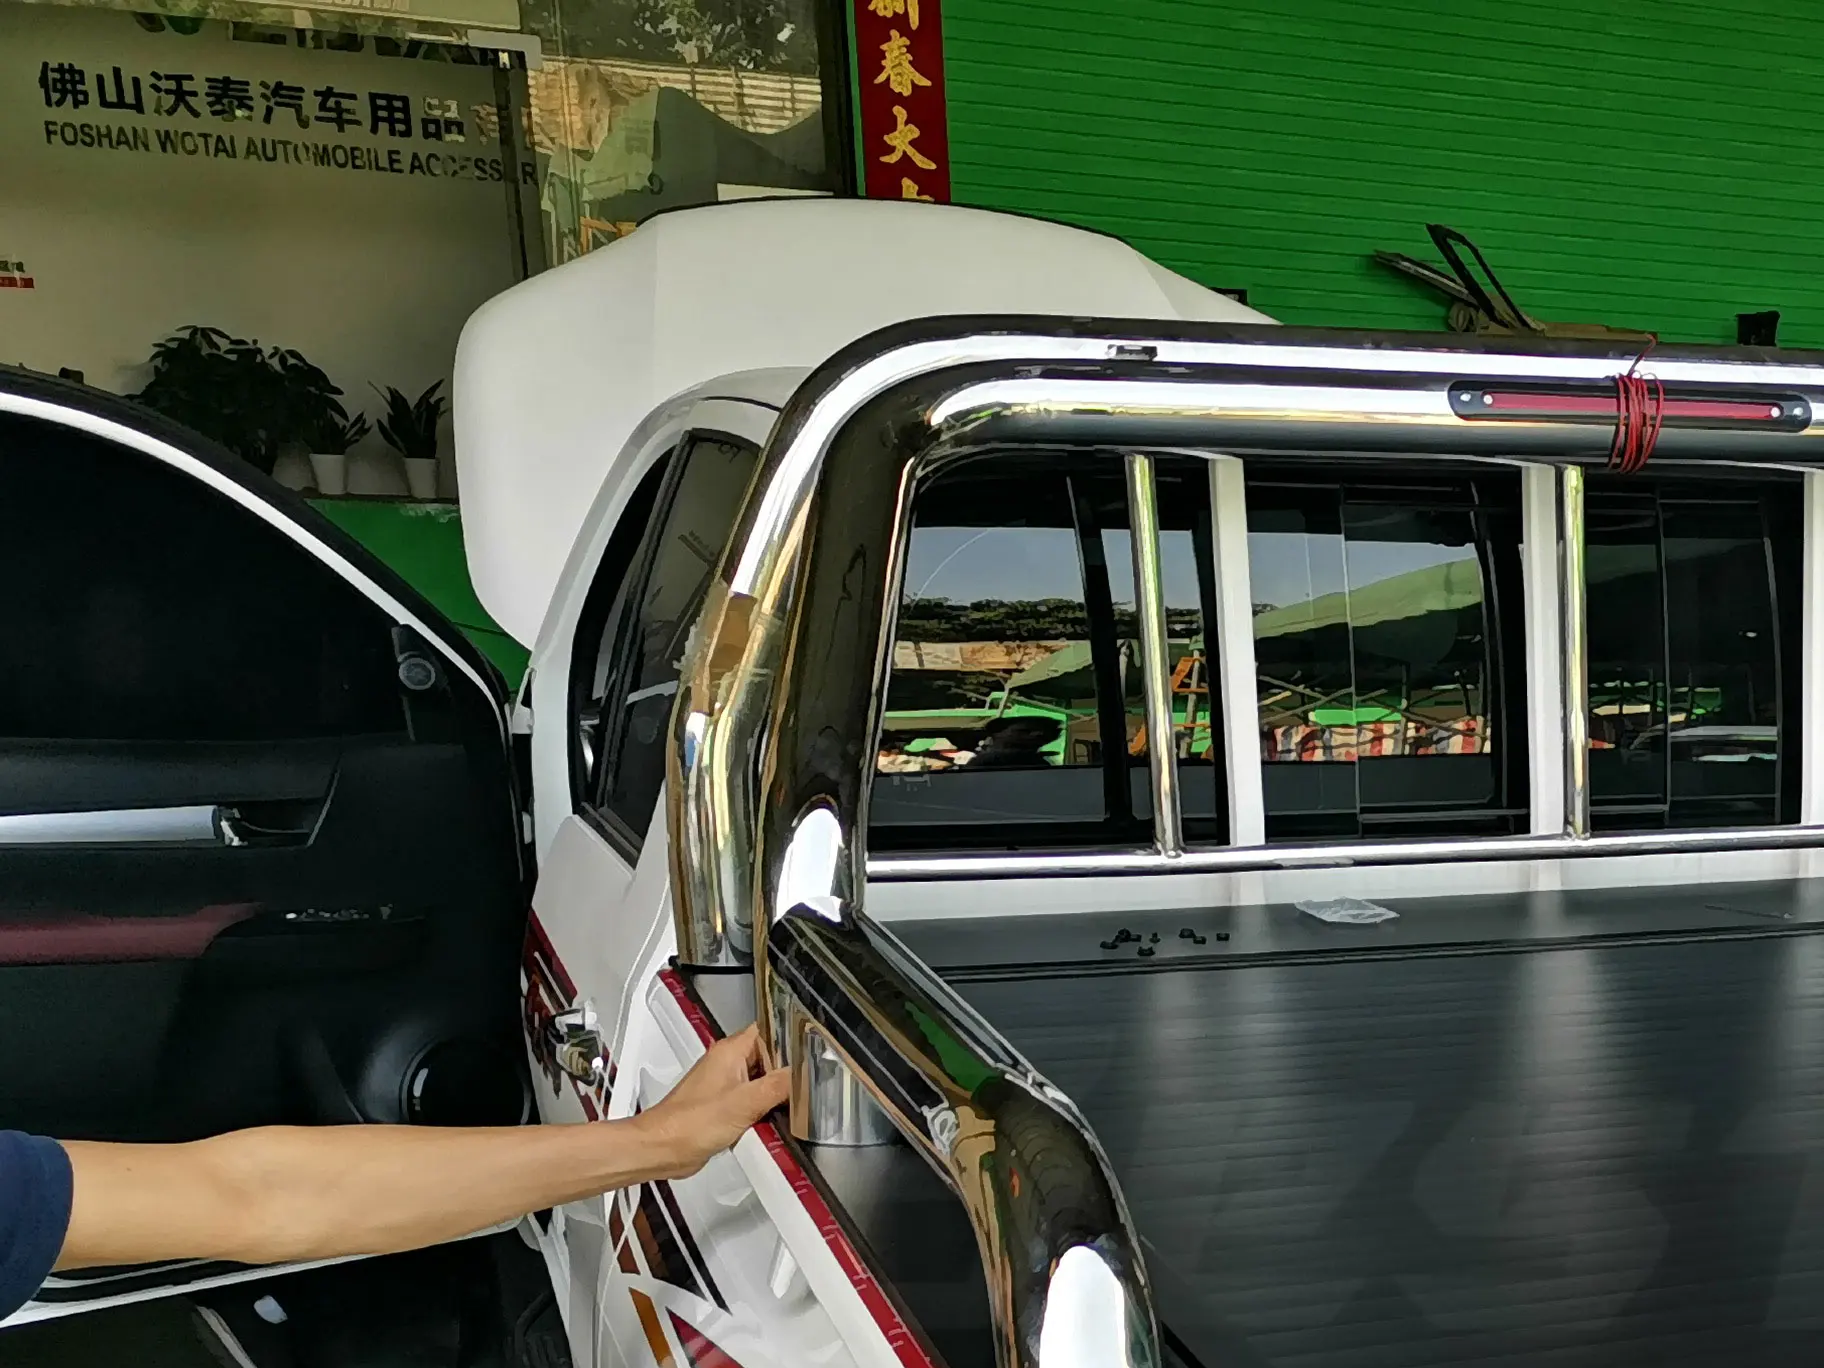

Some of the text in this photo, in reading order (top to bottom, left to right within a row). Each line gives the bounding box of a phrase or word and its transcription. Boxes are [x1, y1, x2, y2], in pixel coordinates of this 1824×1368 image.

[44, 120, 150, 152] FOSHAN
[155, 129, 237, 159] WOTAI
[243, 137, 405, 173] AUTOMOBILE
